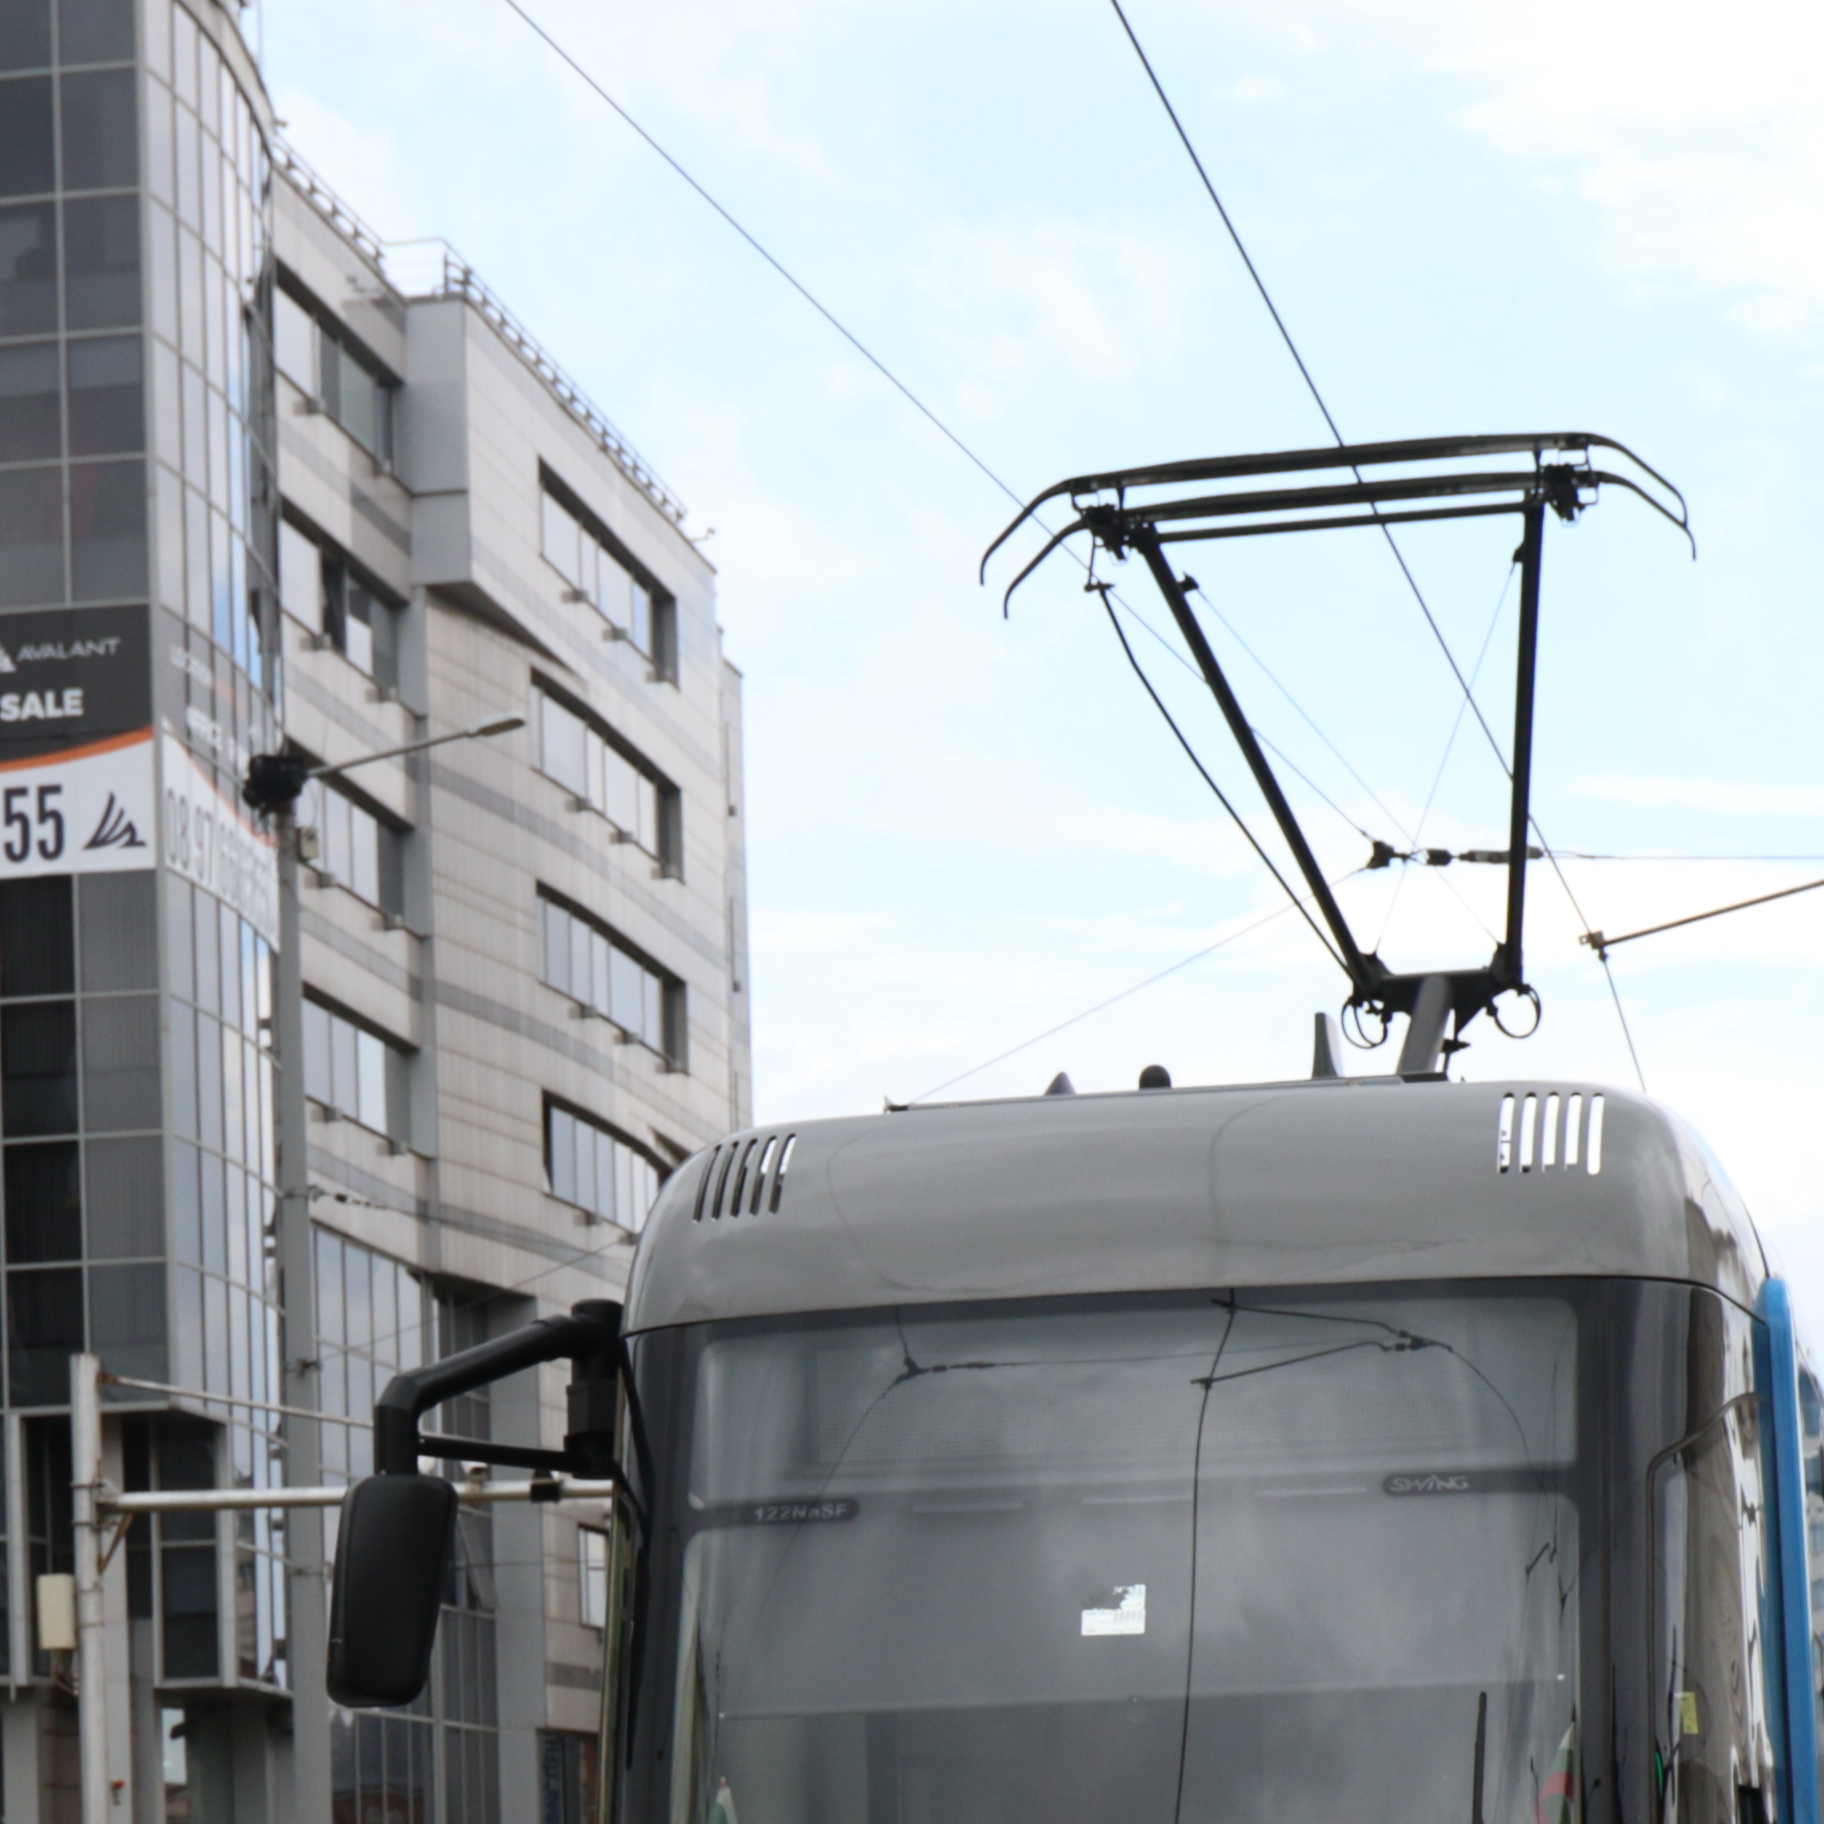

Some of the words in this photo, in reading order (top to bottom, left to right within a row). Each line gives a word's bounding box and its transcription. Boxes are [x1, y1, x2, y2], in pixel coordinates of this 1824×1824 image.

[16, 637, 121, 661] AVALANT
[0, 688, 84, 722] SALE
[3, 784, 65, 862] 55
[1388, 1474, 1469, 1492] SWING
[754, 1502, 849, 1521] 122NaSF
